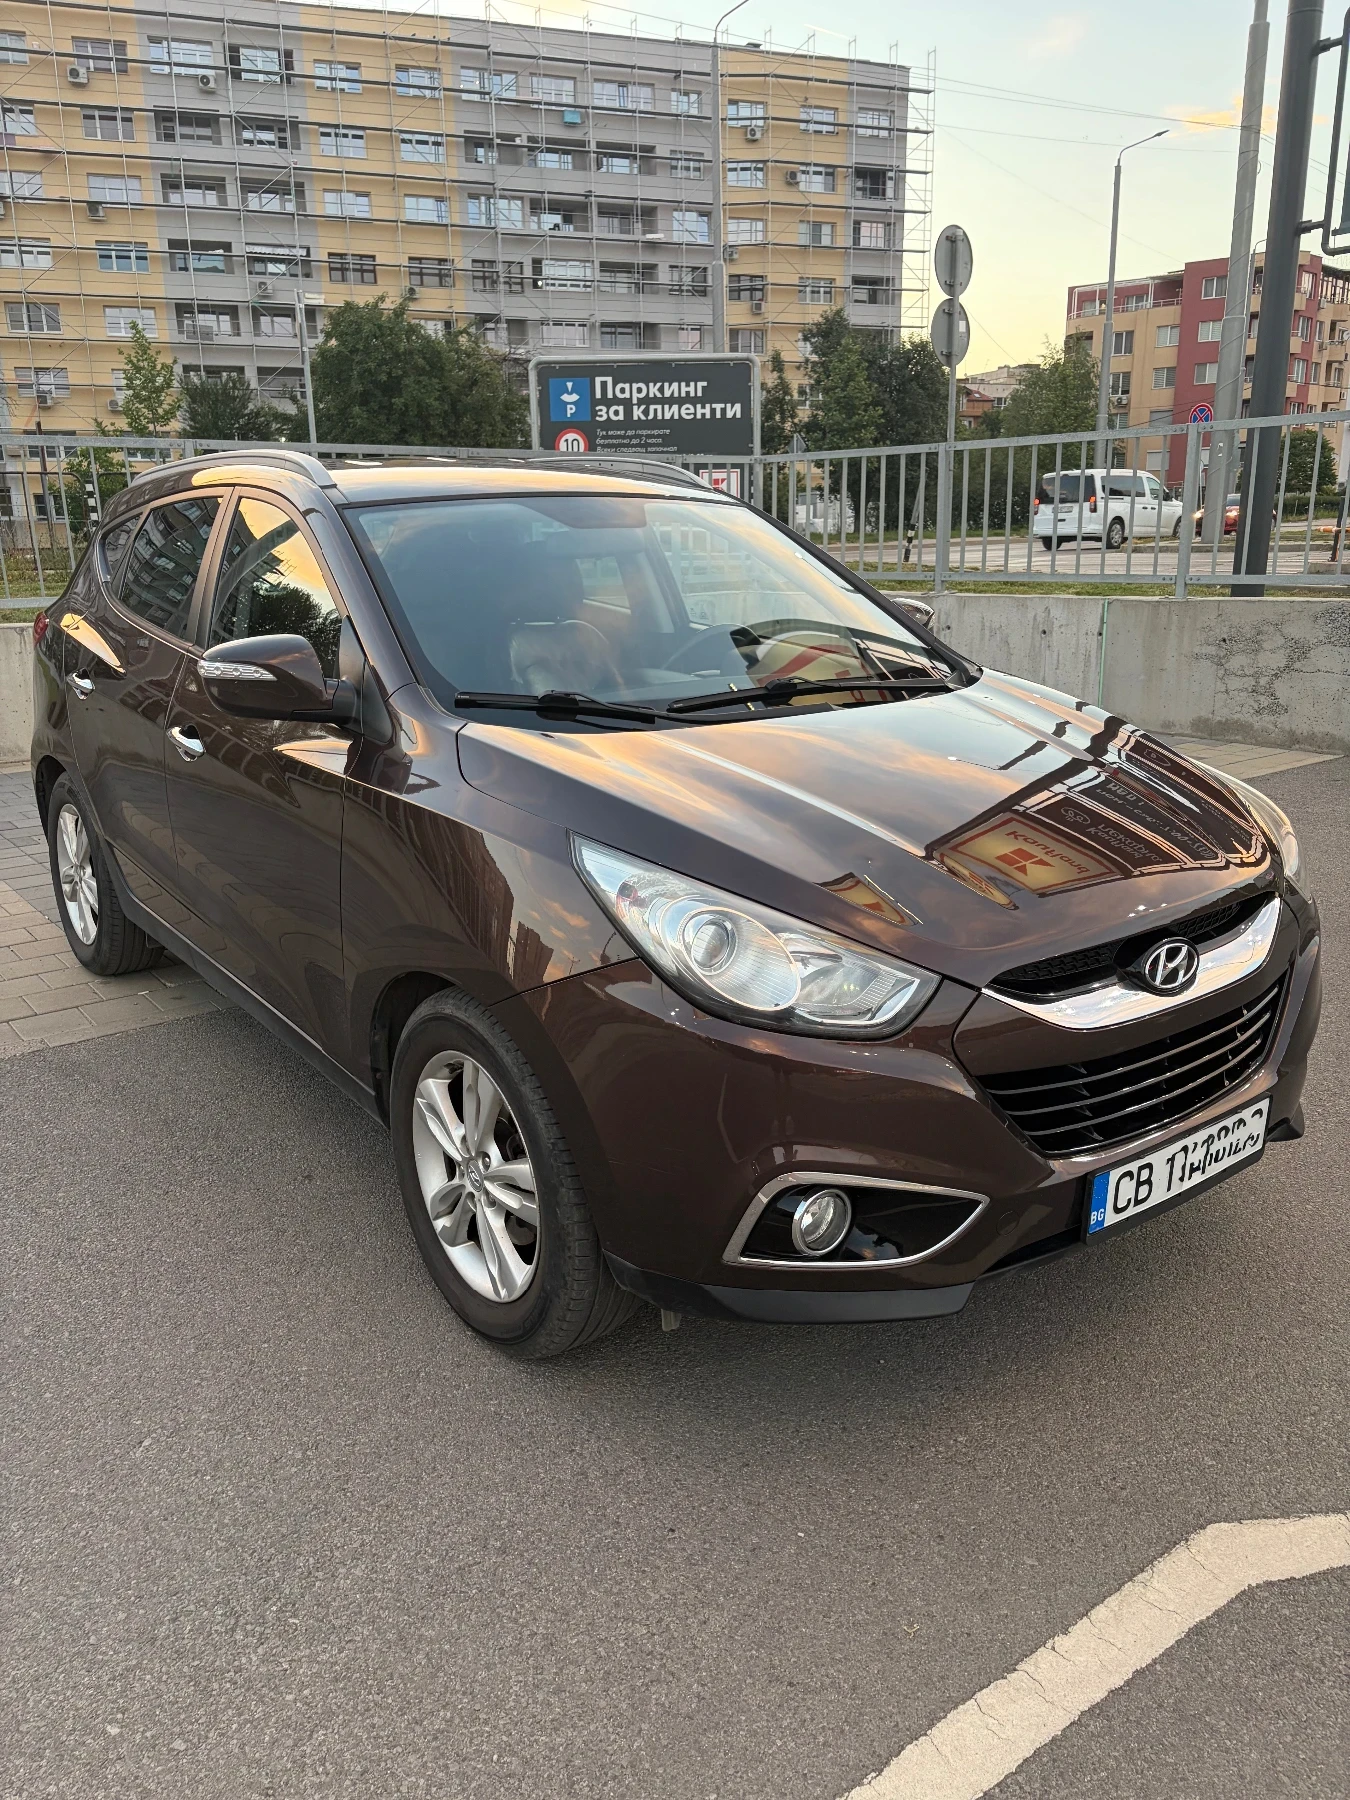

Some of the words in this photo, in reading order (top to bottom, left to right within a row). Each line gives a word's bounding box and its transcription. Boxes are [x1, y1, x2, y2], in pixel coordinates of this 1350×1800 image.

[594, 376, 708, 404] Паркинг
[595, 405, 625, 422] за
[632, 402, 742, 421] клиенти
[596, 429, 607, 437] Тук
[596, 437, 630, 445] безплатно
[563, 438, 580, 452] 10
[1090, 1207, 1105, 1225] BG
